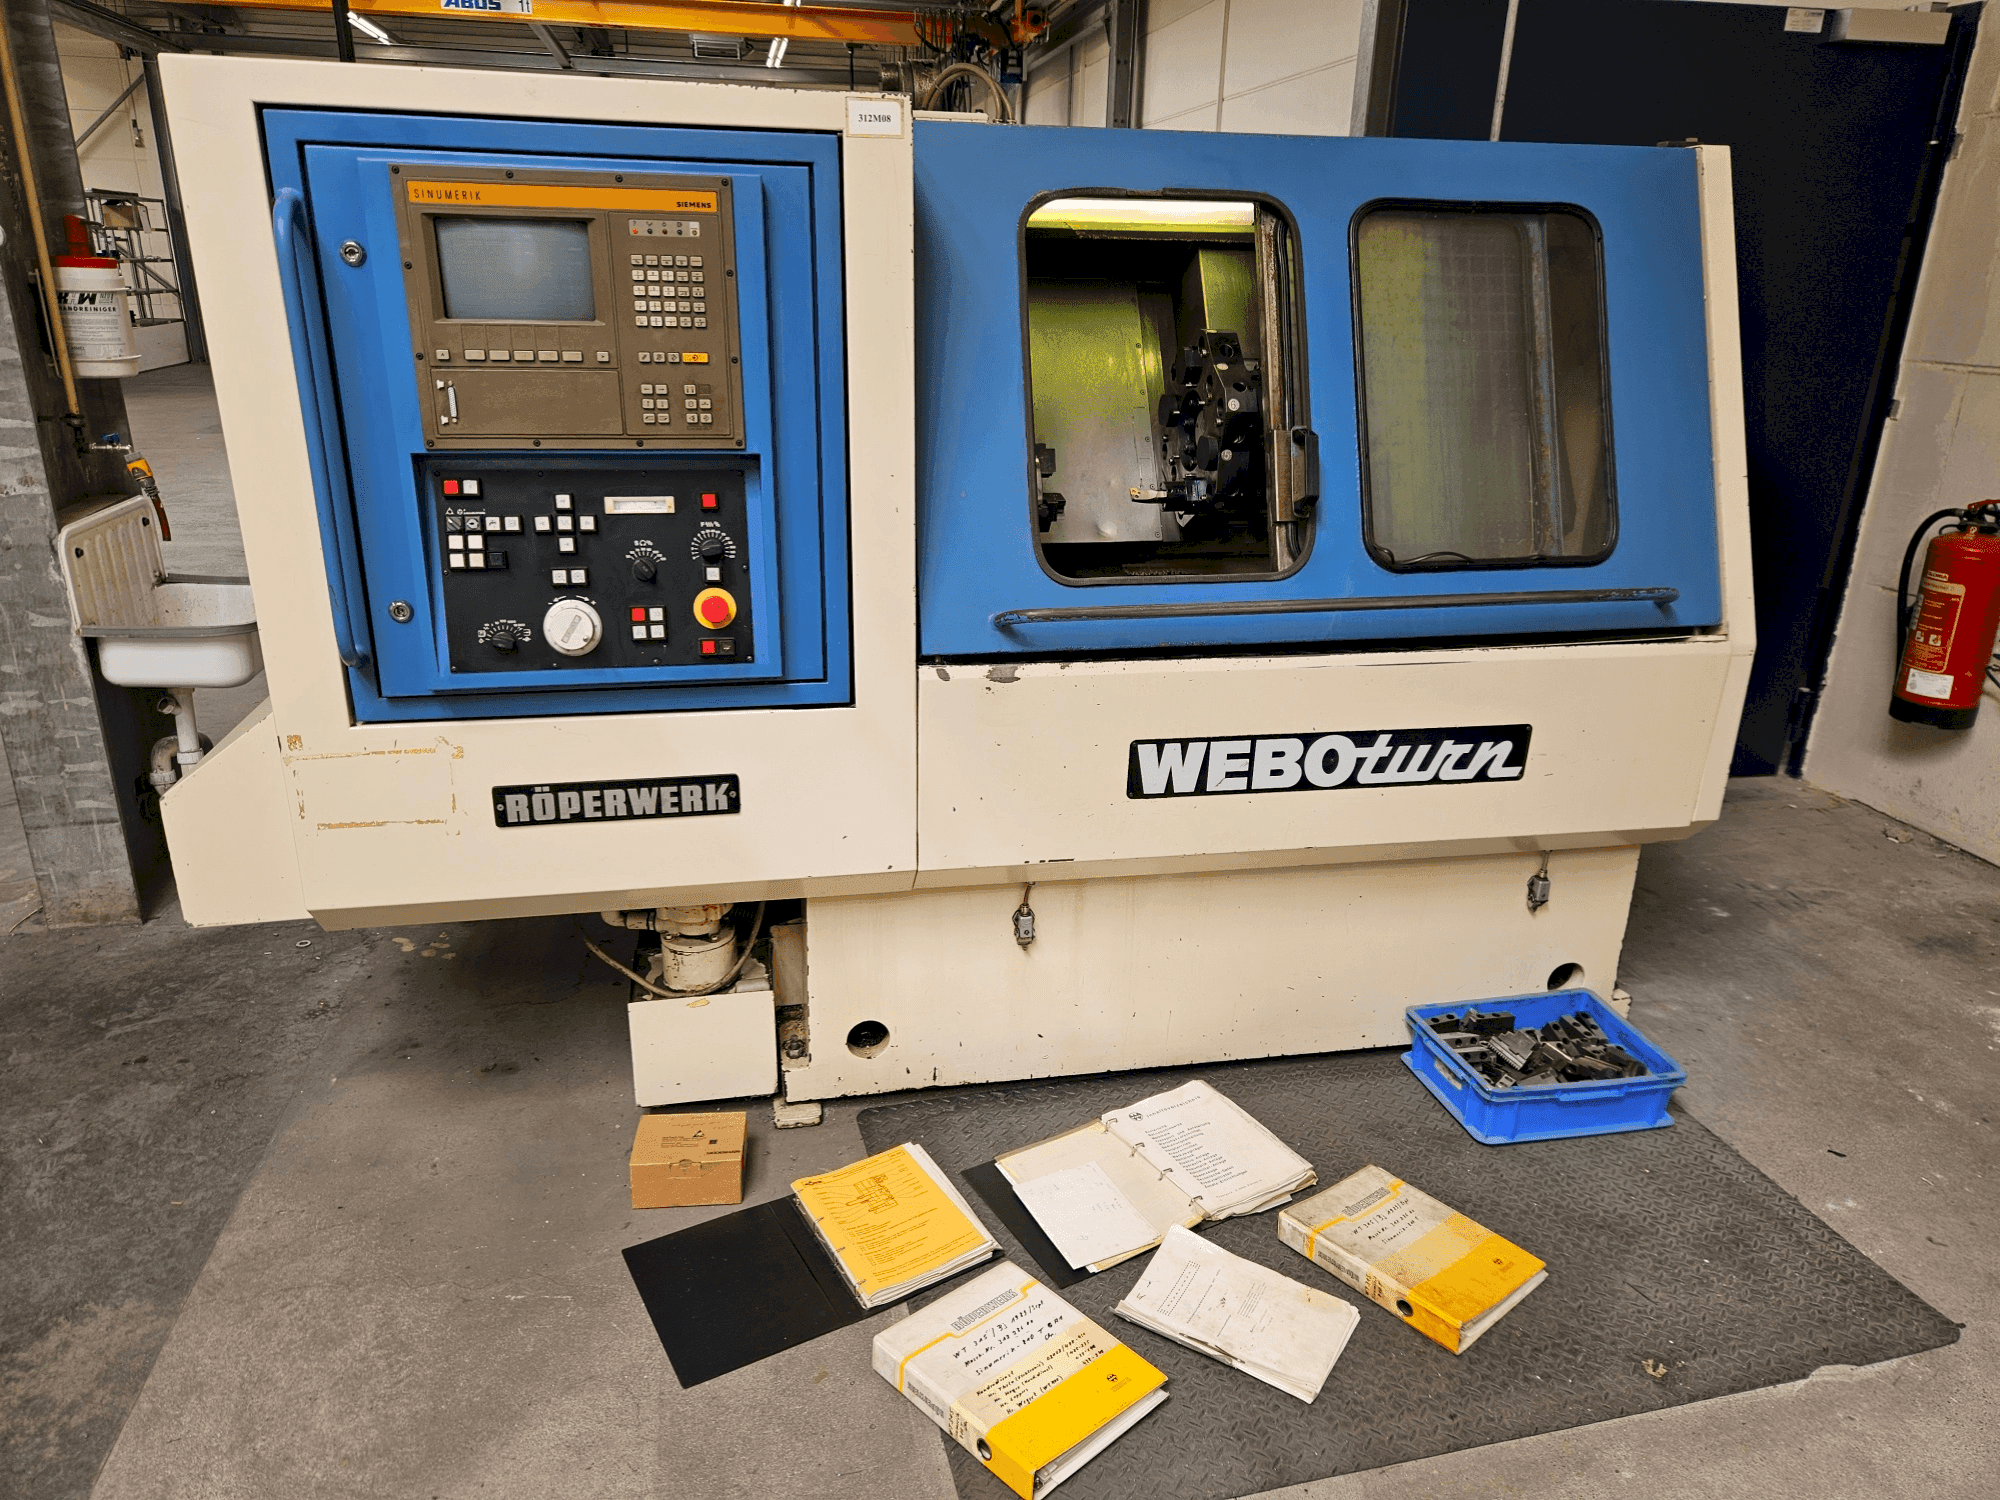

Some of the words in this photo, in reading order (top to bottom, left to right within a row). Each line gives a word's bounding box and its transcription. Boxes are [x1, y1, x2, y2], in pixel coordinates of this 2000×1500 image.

[858, 113, 892, 122] 312M08
[413, 188, 481, 201] SINUMERIK
[676, 201, 712, 209] SIEMENS
[1137, 733, 1523, 794] WEBOturn
[504, 783, 730, 823] RÖPERWERK
